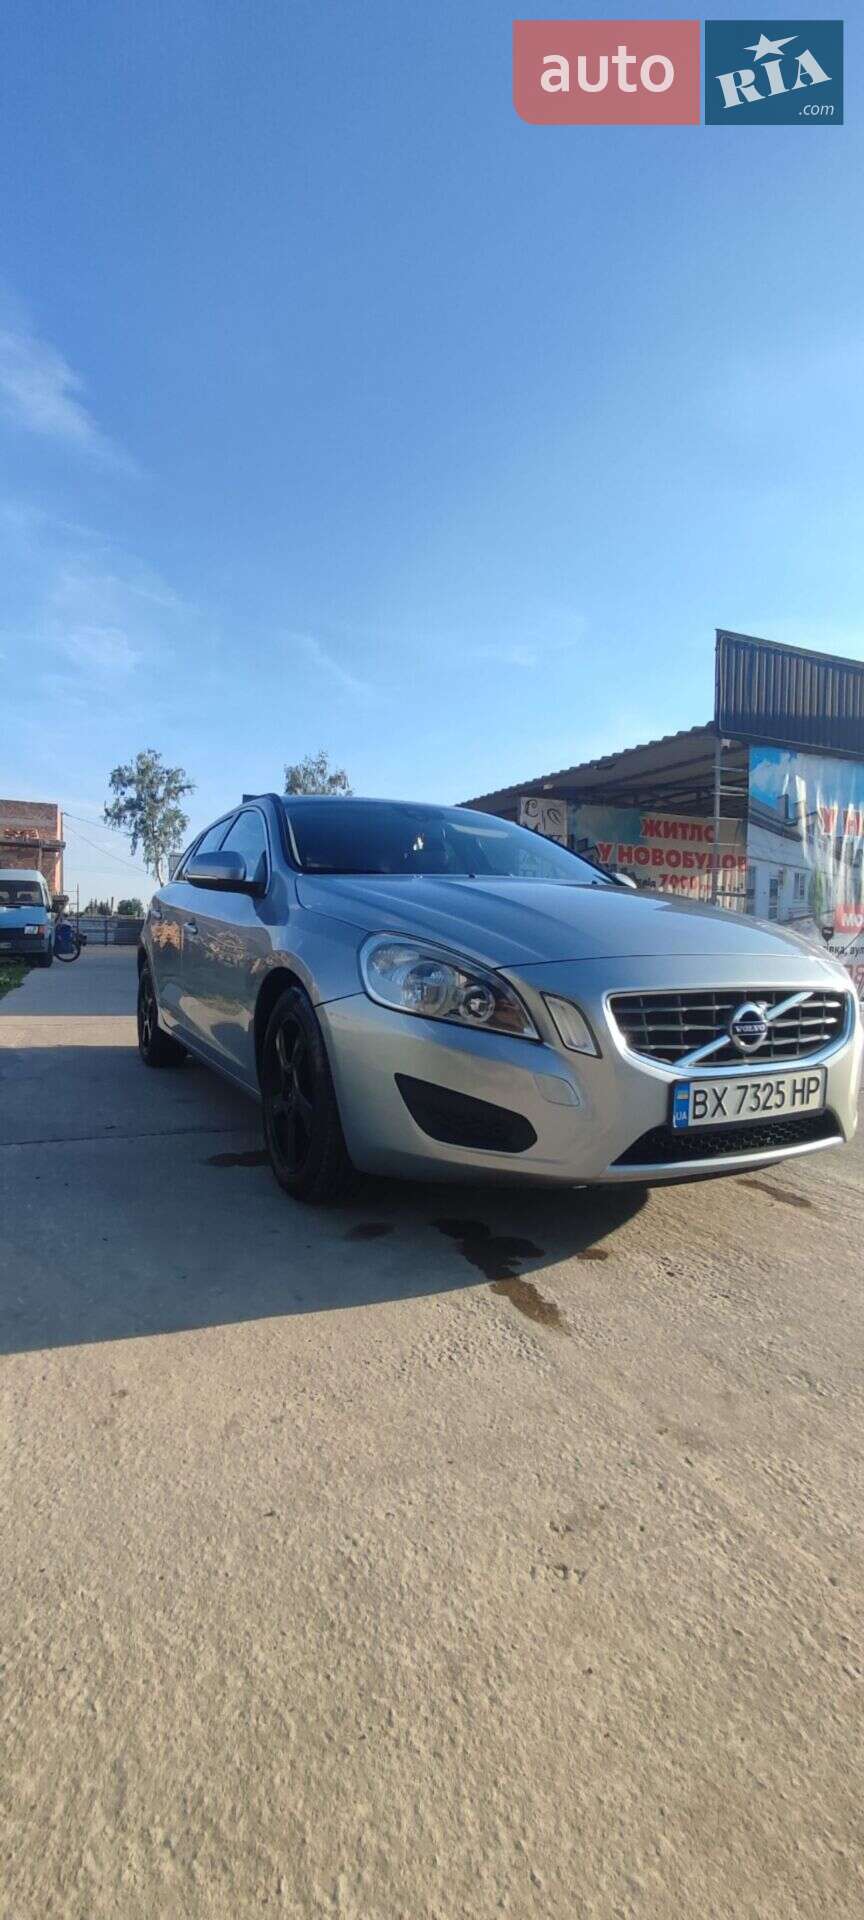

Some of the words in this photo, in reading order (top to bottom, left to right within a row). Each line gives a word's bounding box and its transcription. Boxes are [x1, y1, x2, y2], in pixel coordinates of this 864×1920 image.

[735, 1024, 766, 1033] VOLVO
[736, 1081, 786, 1115] 7325
[675, 1111, 687, 1121] UA
